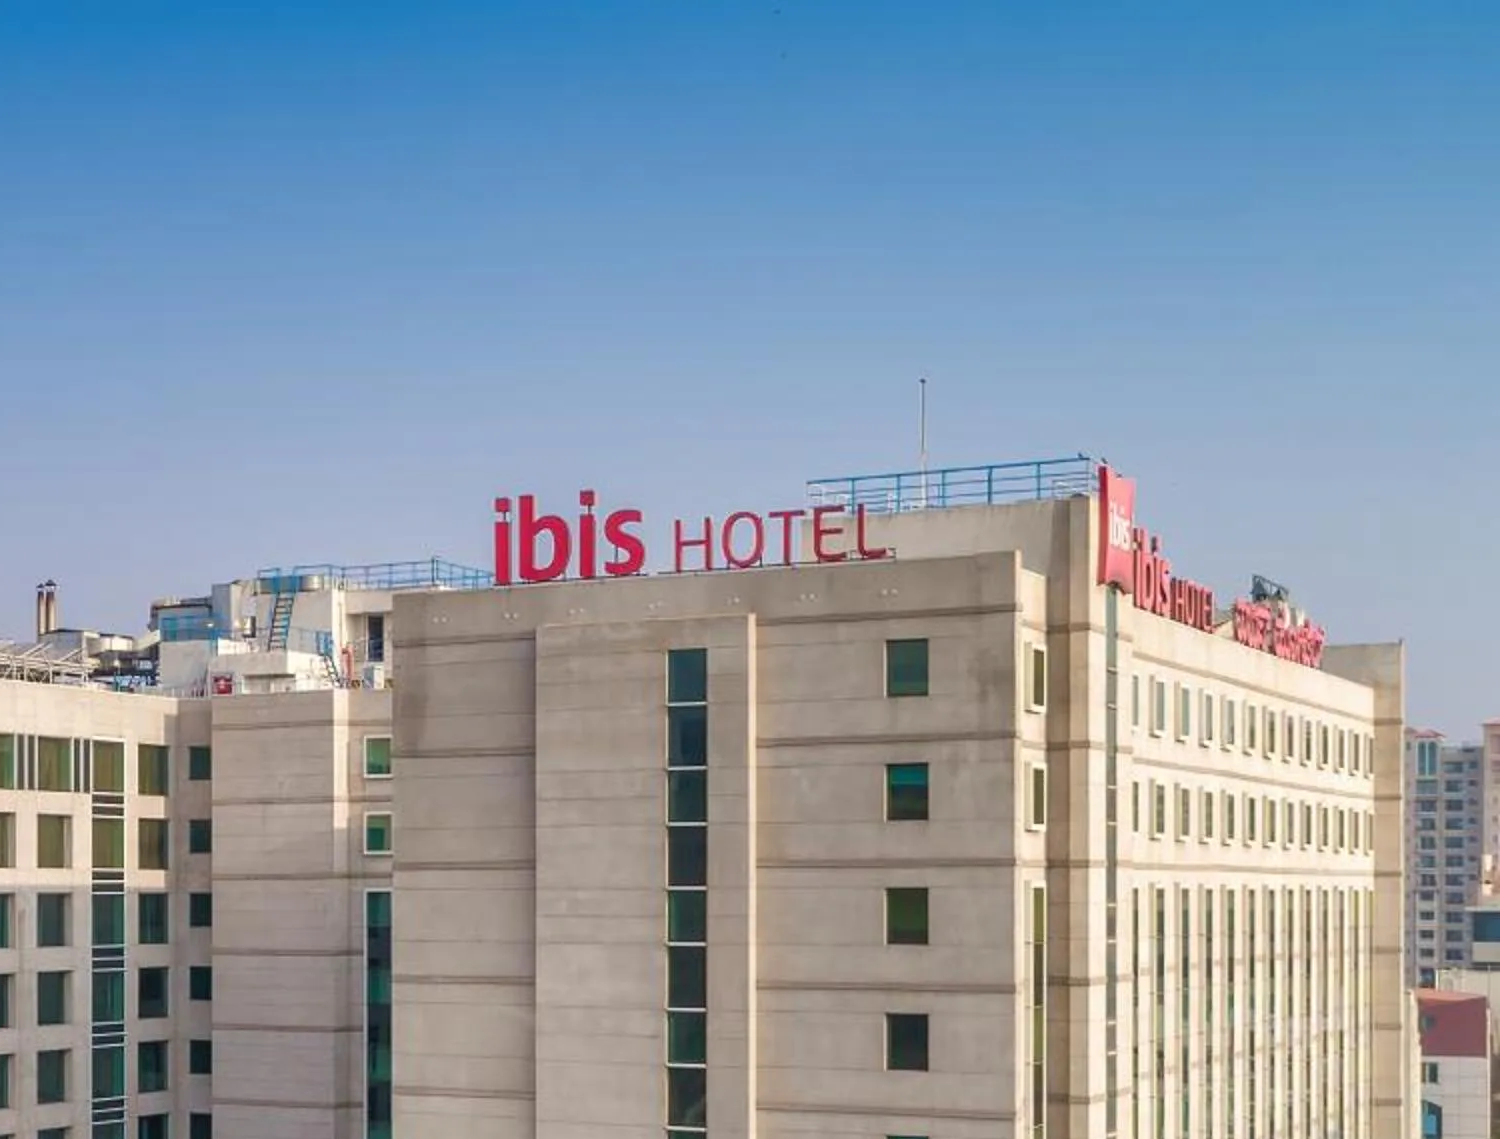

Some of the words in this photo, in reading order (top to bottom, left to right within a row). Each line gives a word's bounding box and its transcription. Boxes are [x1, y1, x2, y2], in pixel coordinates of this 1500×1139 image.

[494, 490, 646, 586] ibis
[675, 503, 887, 573] HOTEL
[1108, 501, 1131, 551] ibis
[1133, 527, 1171, 617] ibis
